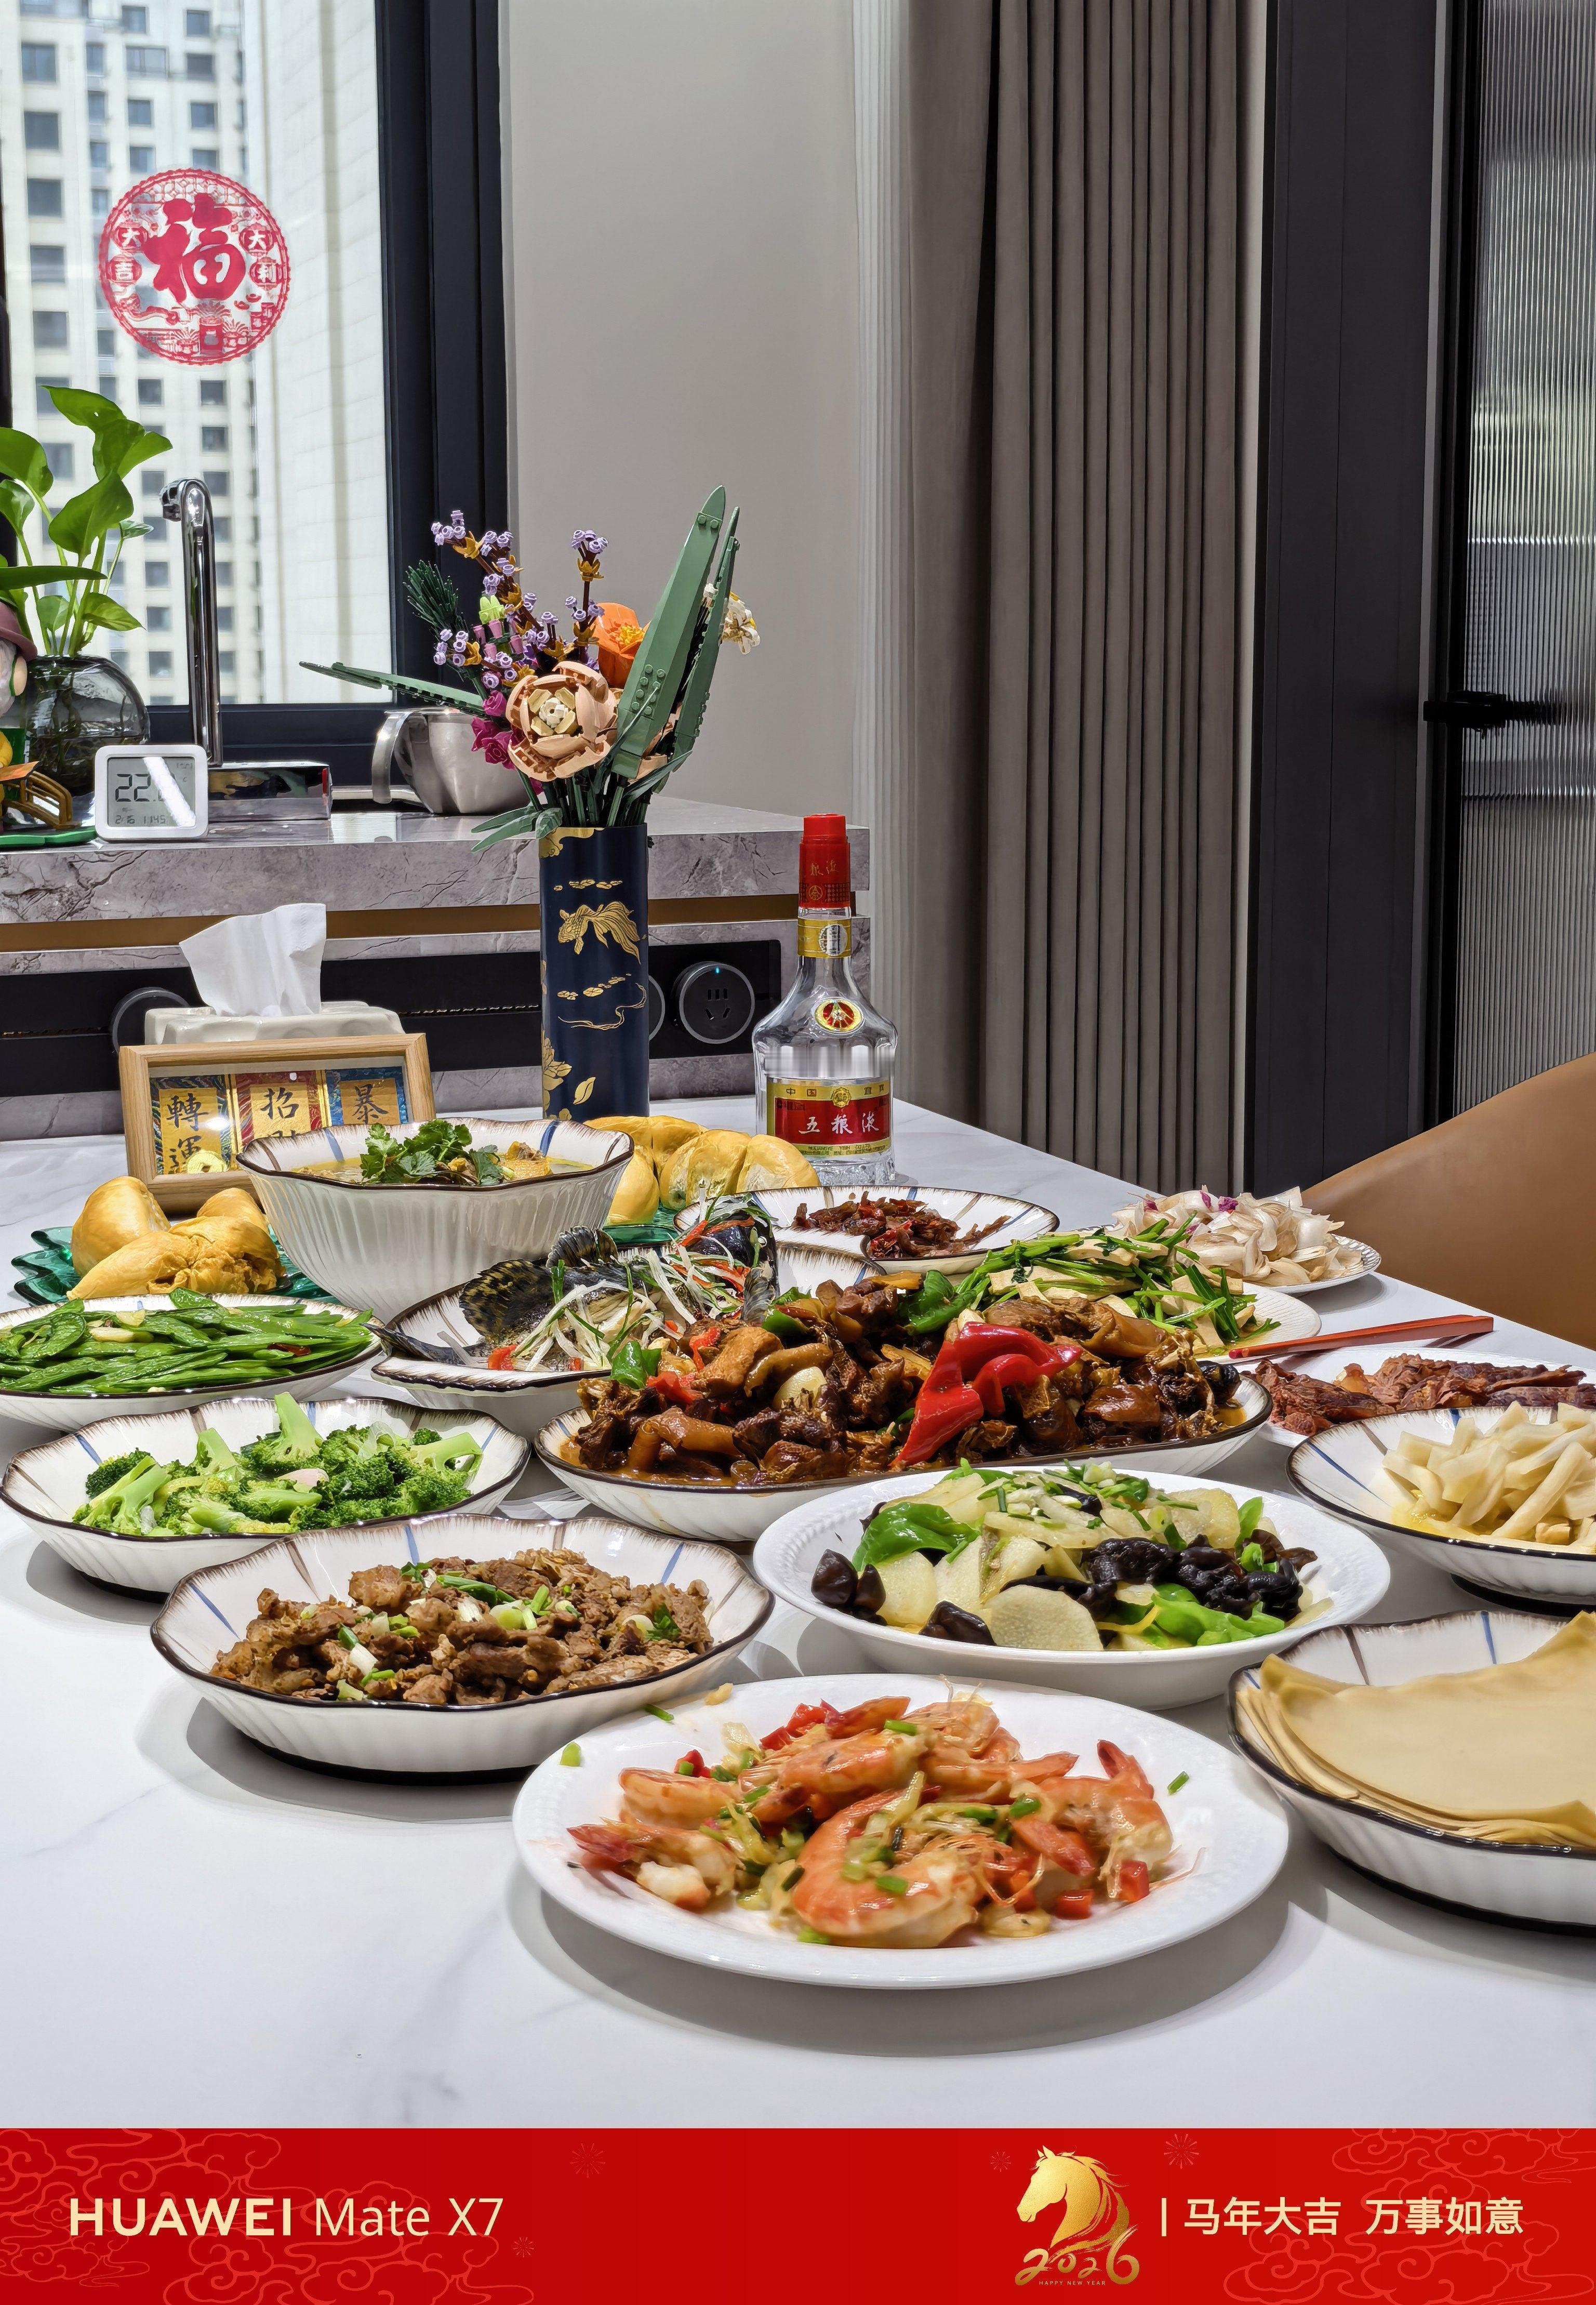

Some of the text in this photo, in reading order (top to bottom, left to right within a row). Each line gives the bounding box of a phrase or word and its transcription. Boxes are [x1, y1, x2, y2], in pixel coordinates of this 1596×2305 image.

[141, 193, 246, 304] 福
[352, 1084, 389, 1124] 暴
[786, 1088, 817, 1096] 中国
[799, 1111, 879, 1134] 五粮液
